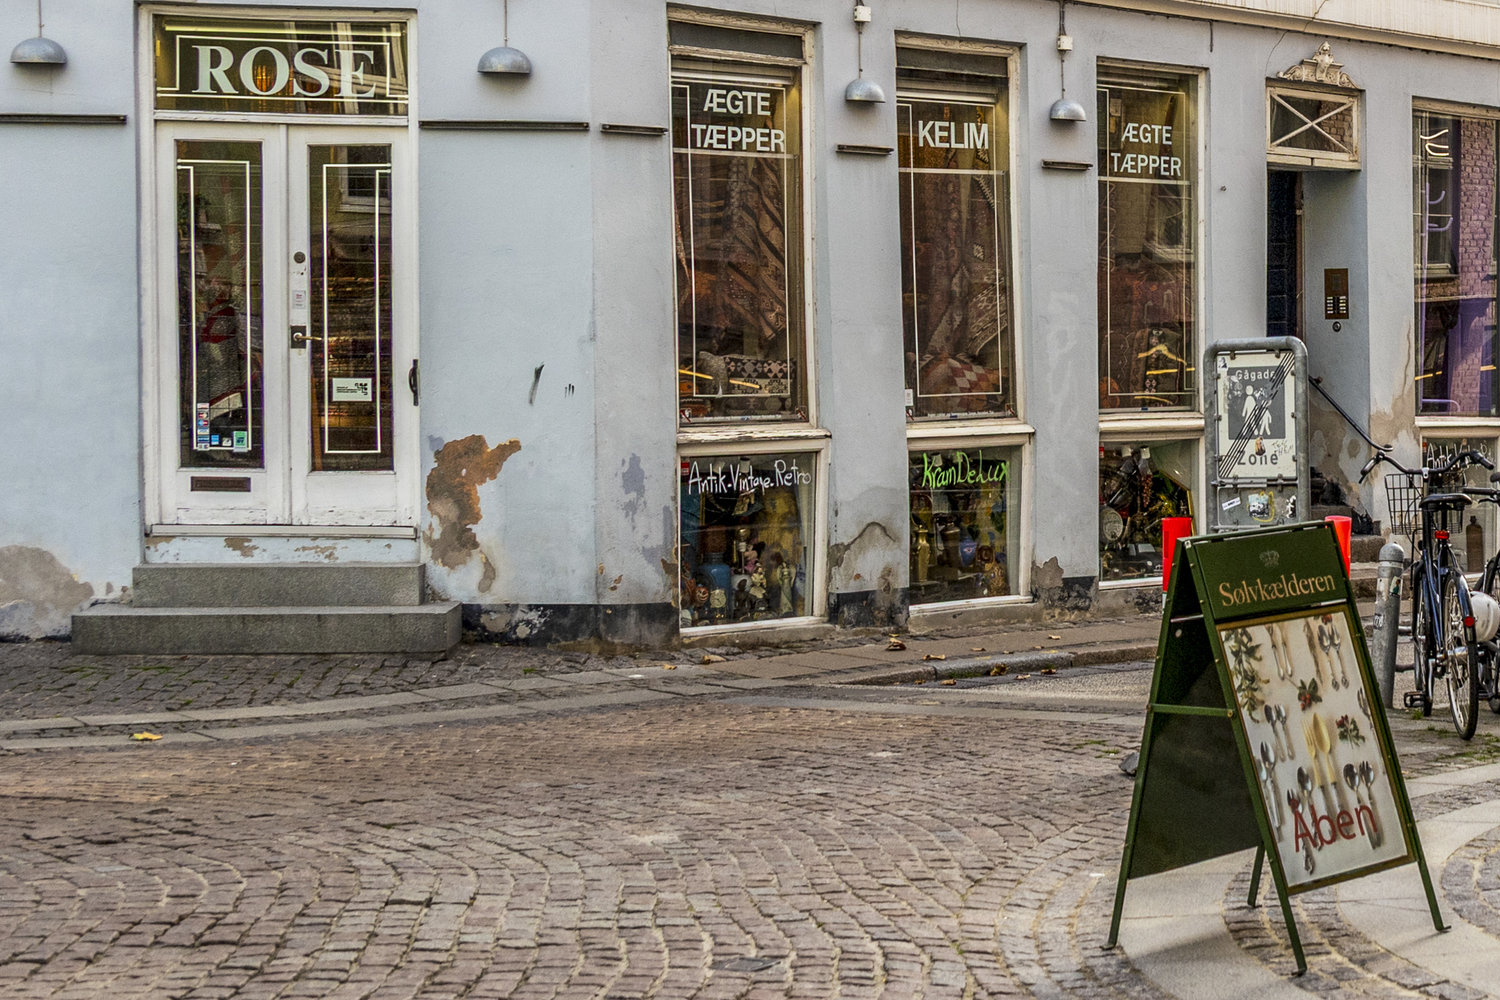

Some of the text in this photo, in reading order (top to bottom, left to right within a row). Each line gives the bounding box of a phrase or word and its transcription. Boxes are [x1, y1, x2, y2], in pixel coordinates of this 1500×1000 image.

[191, 44, 377, 98] ROSE
[703, 88, 771, 116] ÆGTE
[690, 123, 786, 152] TÆPPER
[918, 120, 989, 149] KELIM
[1121, 122, 1173, 145] ÆGTE
[1110, 152, 1181, 176] TÆPPER
[1235, 369, 1276, 382] Gågade
[1237, 451, 1279, 465] Zone
[1219, 573, 1336, 607] Sølvkælderen
